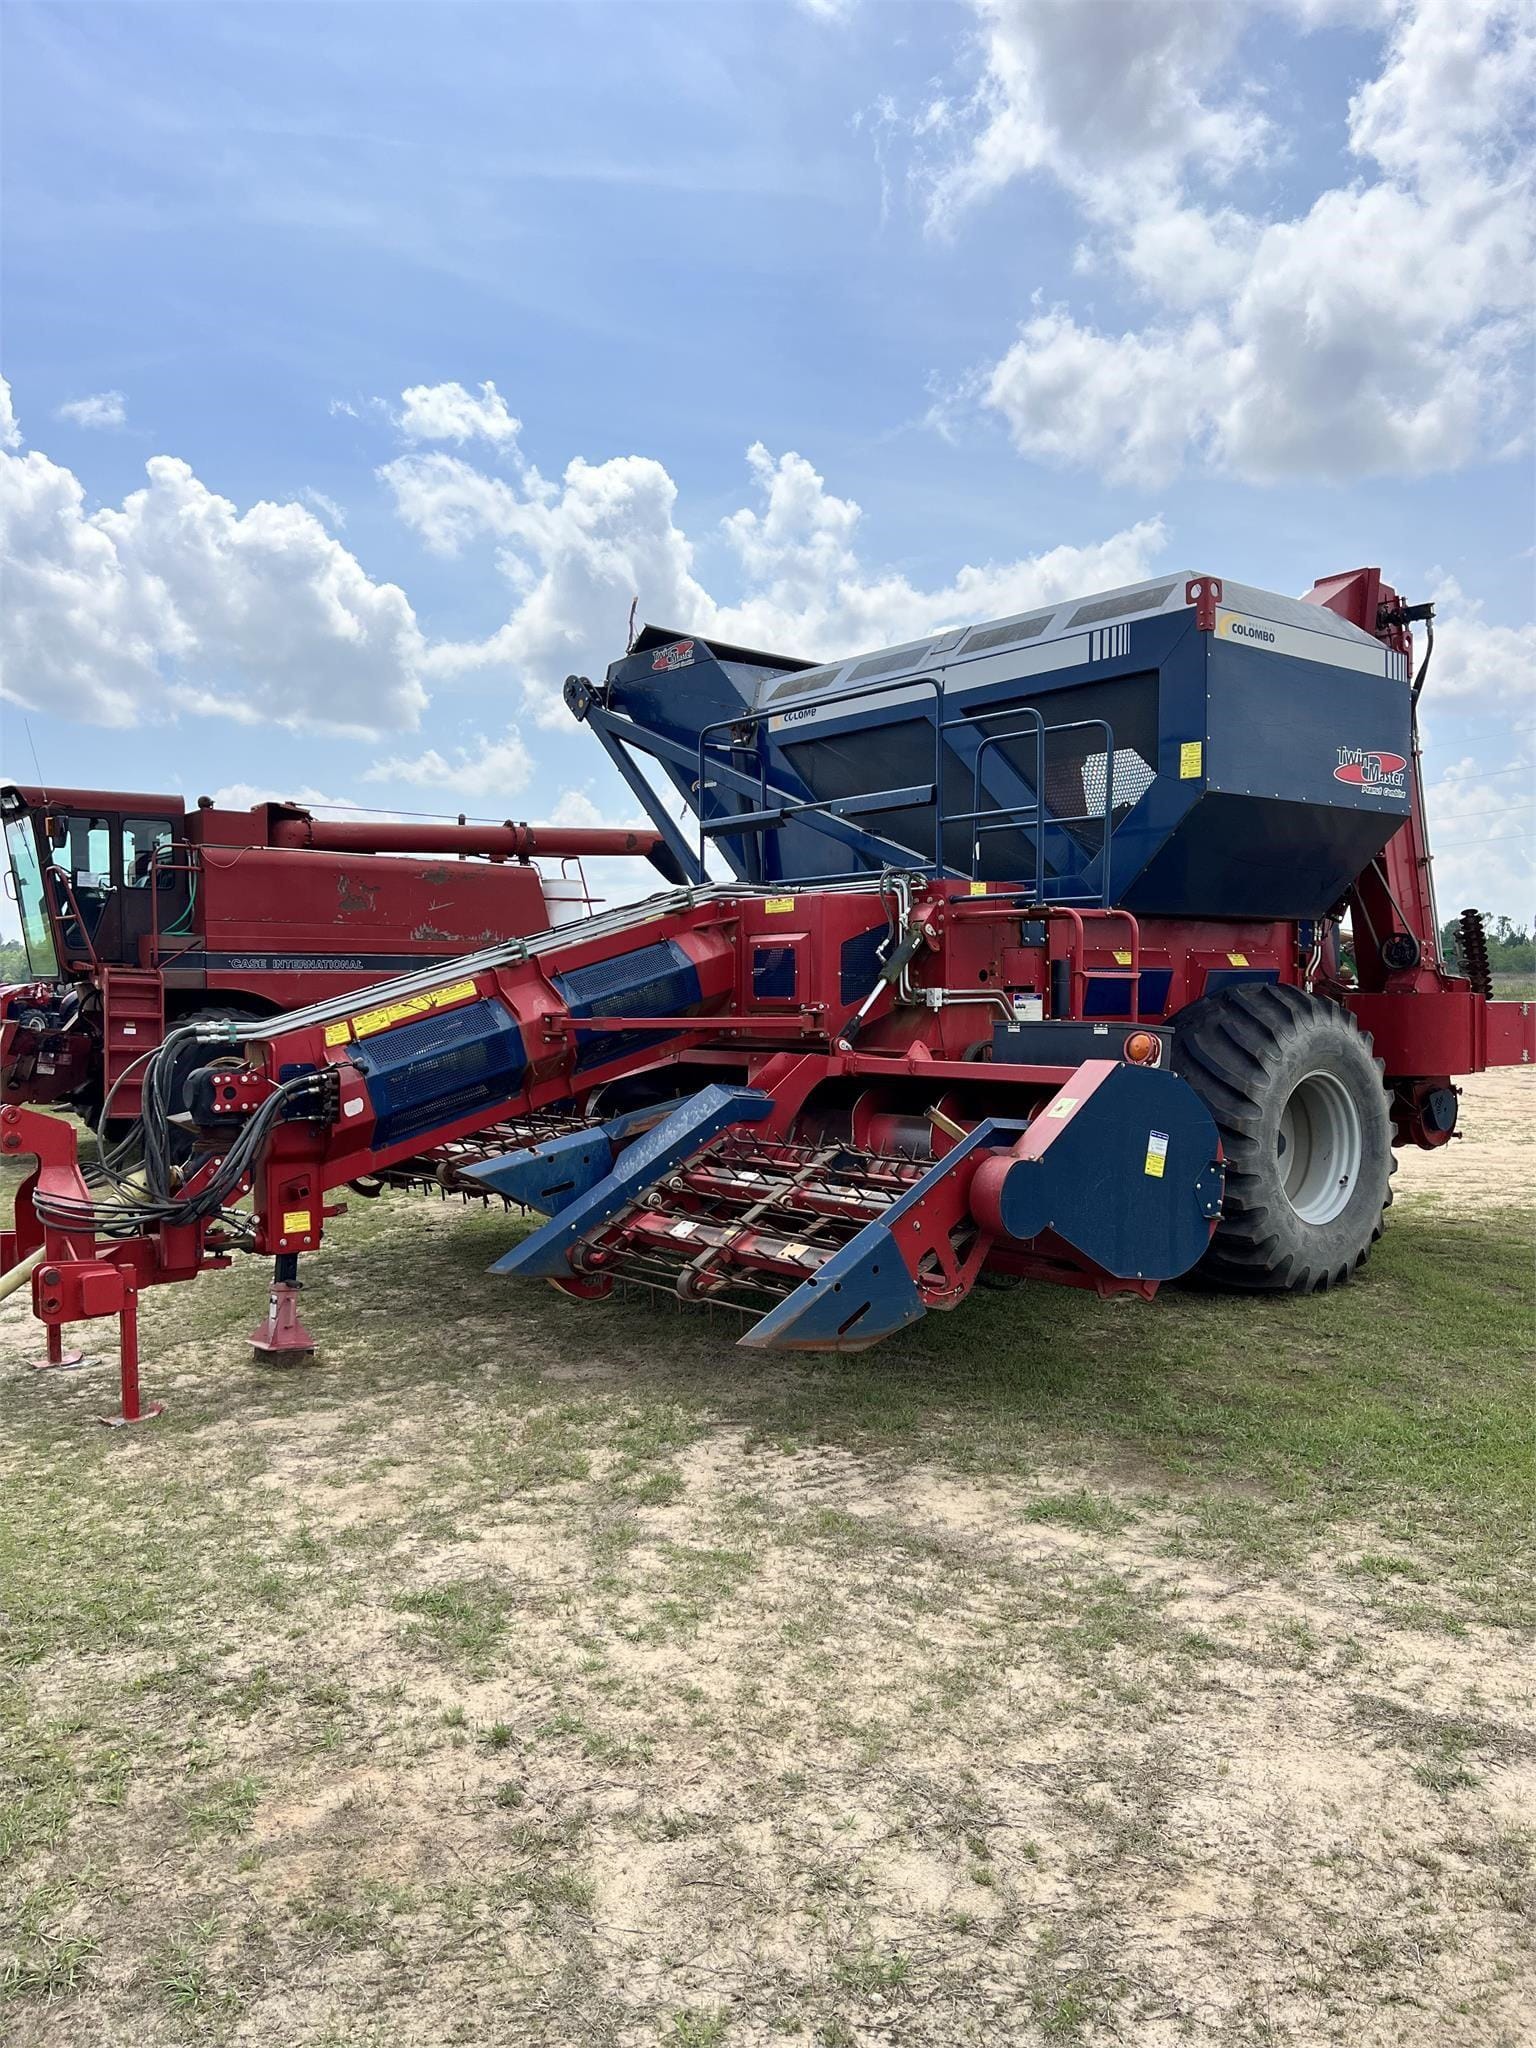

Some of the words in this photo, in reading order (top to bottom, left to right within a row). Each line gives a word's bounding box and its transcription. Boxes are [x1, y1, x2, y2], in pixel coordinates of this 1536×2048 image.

[1231, 623, 1275, 643] COLOMBO
[1336, 746, 1369, 769] Twin
[1367, 763, 1405, 786] Master
[231, 958, 267, 969] CASE
[272, 959, 364, 970] INTERNATIONAL
